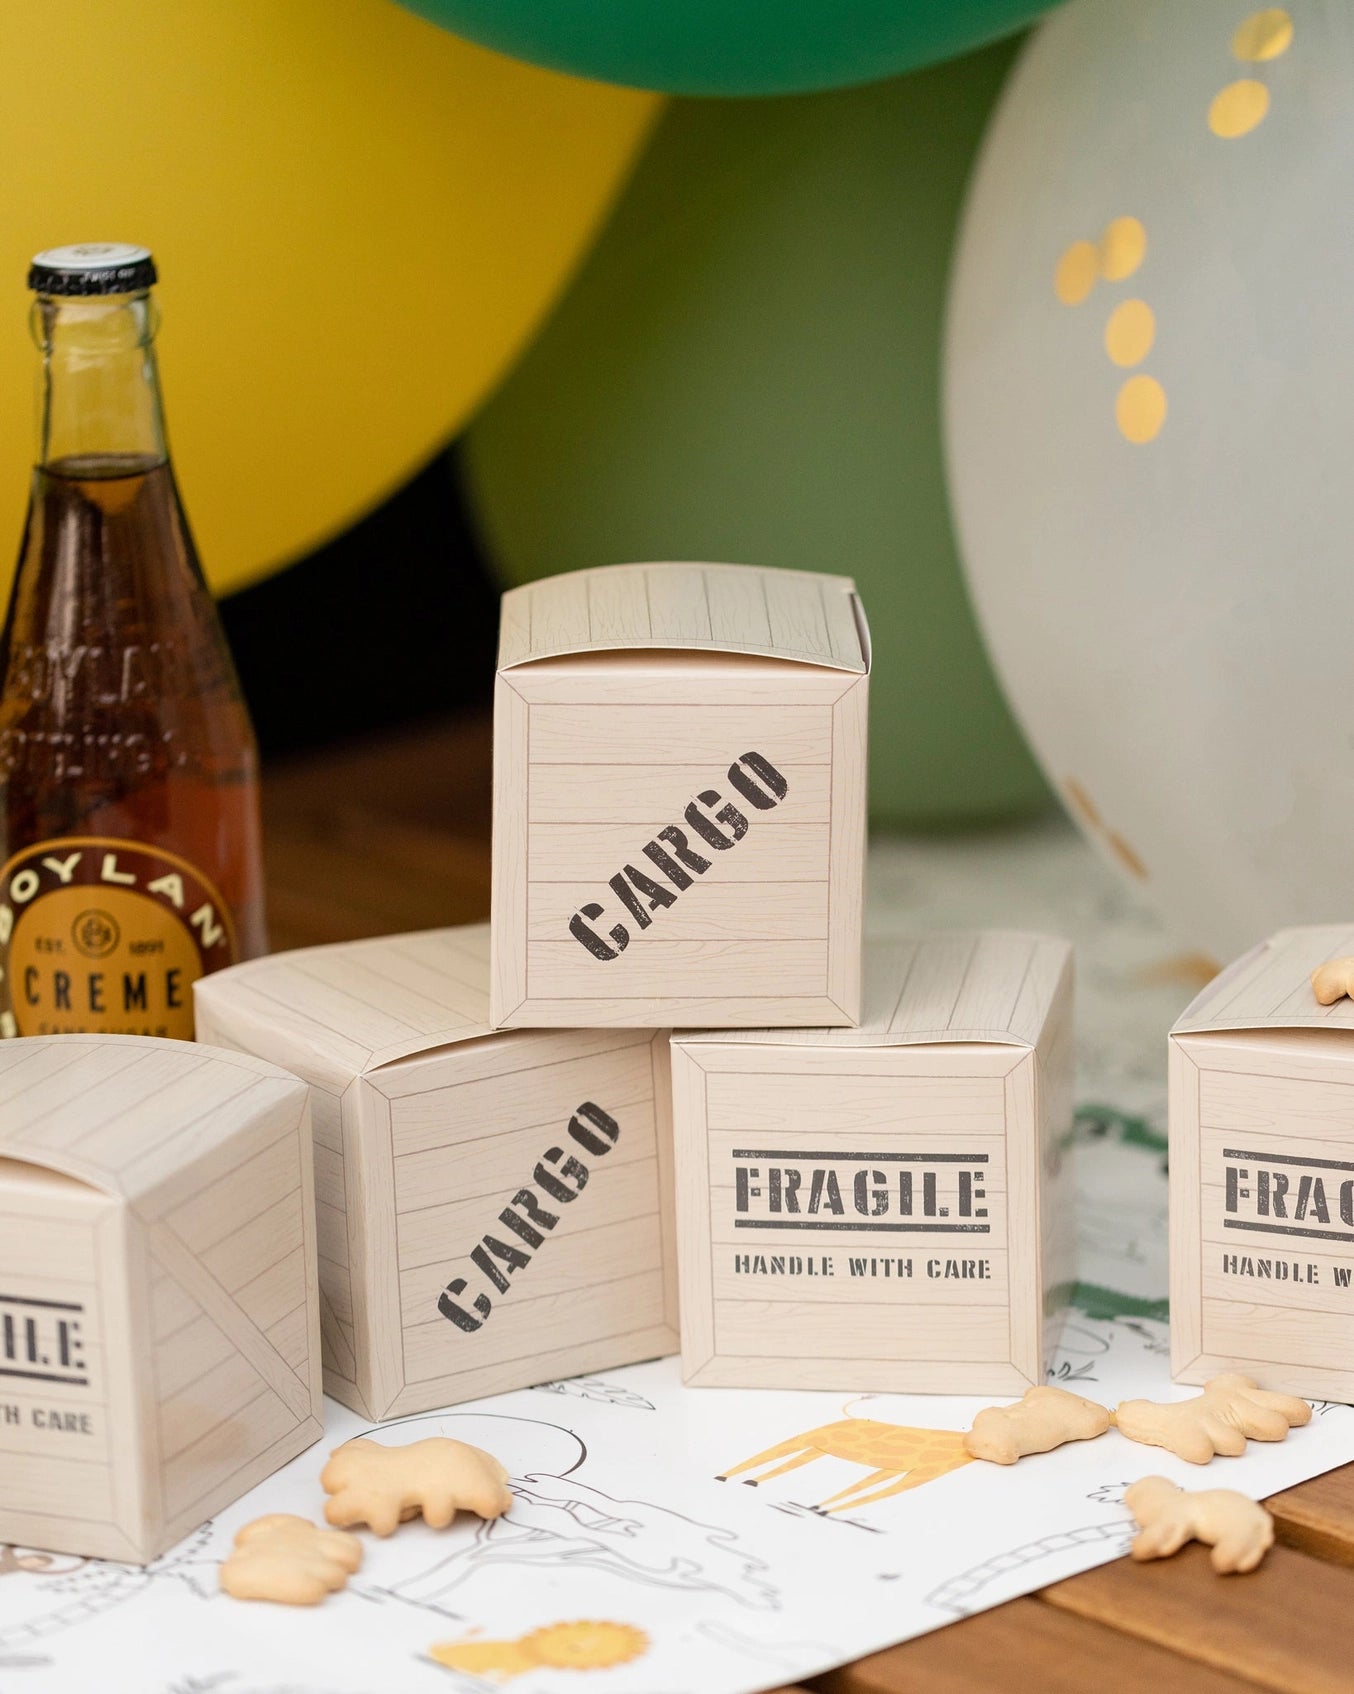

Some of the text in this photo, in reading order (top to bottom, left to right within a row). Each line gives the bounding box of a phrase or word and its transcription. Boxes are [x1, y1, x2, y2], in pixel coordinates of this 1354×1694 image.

[568, 751, 789, 962] CARGO
[24, 965, 183, 1013] CREME
[735, 1166, 989, 1218] FRAGILE
[436, 1101, 620, 1333] CARGO
[734, 1254, 992, 1280] HANDLE WITH CARE
[1223, 1254, 1320, 1285] HANDLE
[0, 1404, 94, 1435] H CARE
